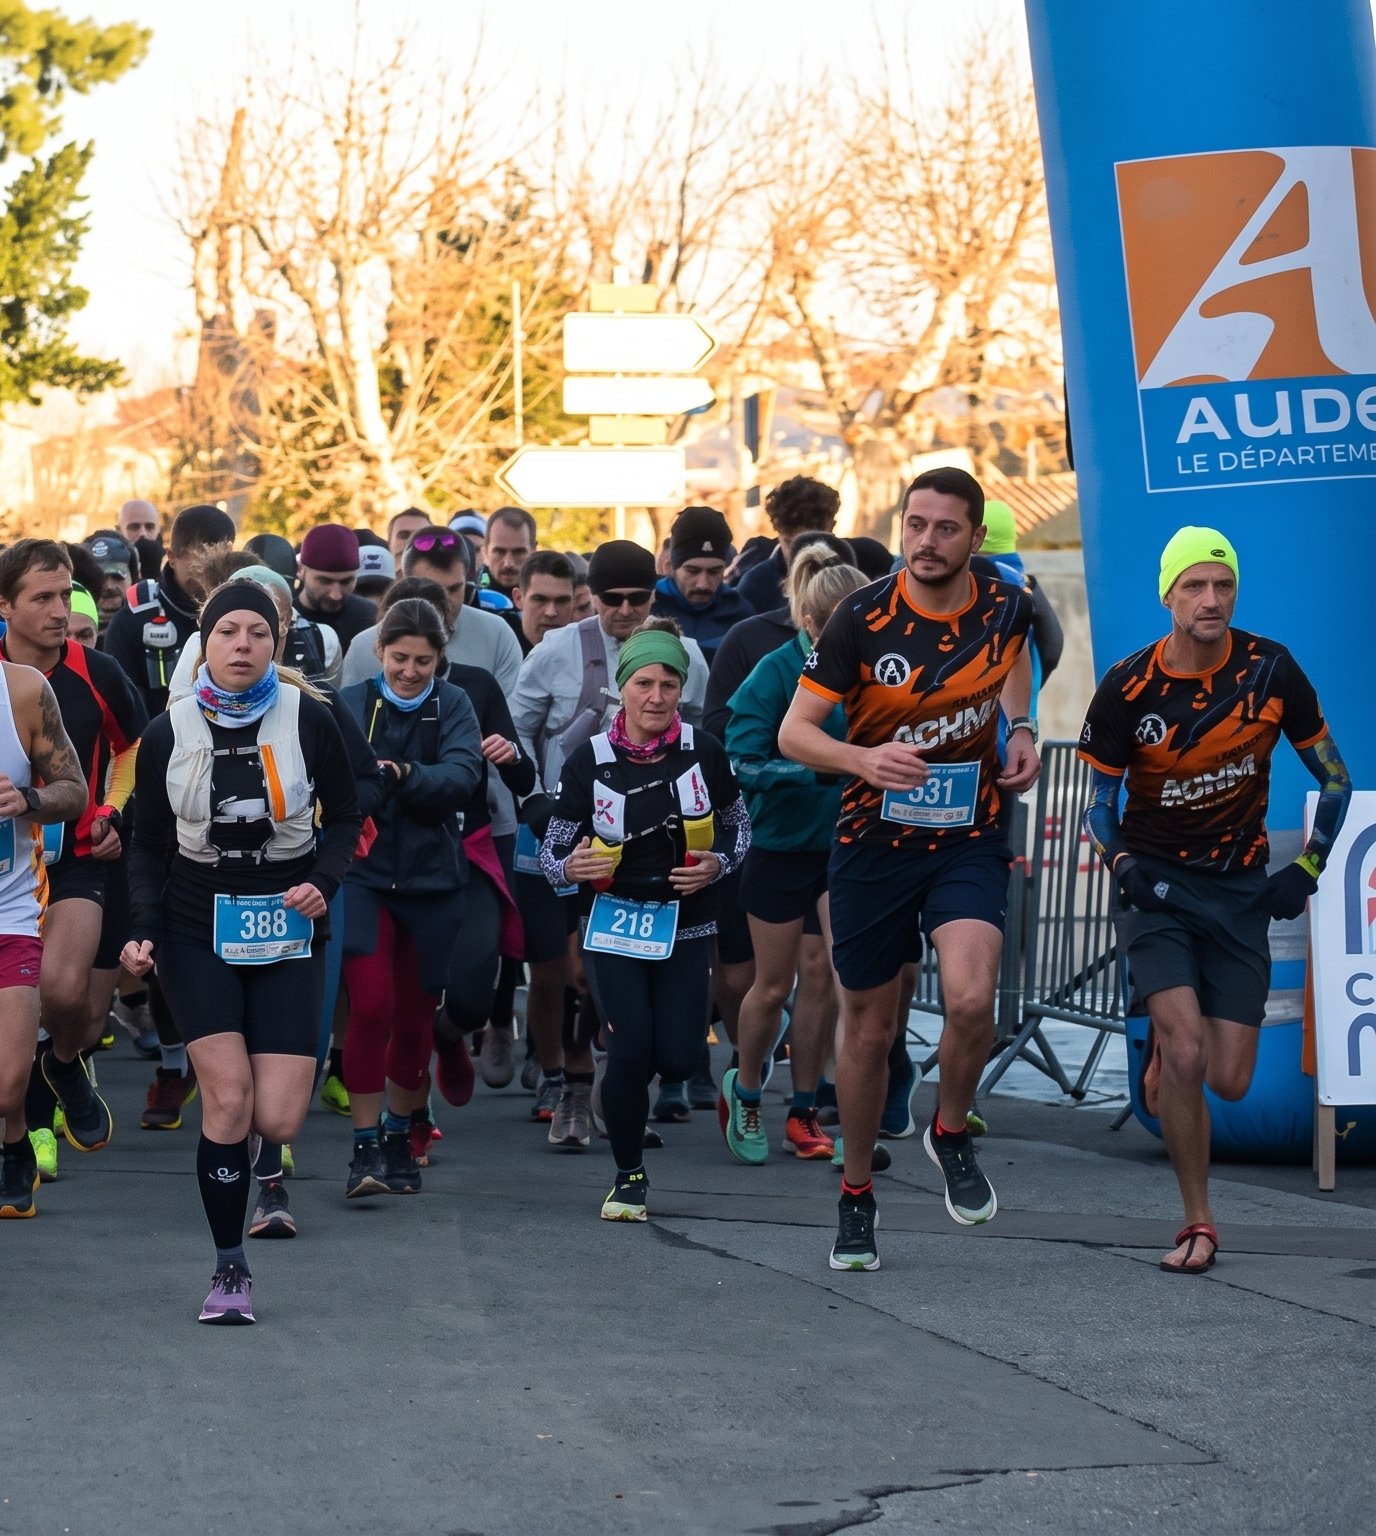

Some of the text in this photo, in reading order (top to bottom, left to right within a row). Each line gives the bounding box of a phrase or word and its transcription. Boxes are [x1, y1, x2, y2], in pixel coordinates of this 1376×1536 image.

[1177, 453, 1210, 474] LE
[240, 908, 288, 940] 388
[610, 908, 655, 938] 218
